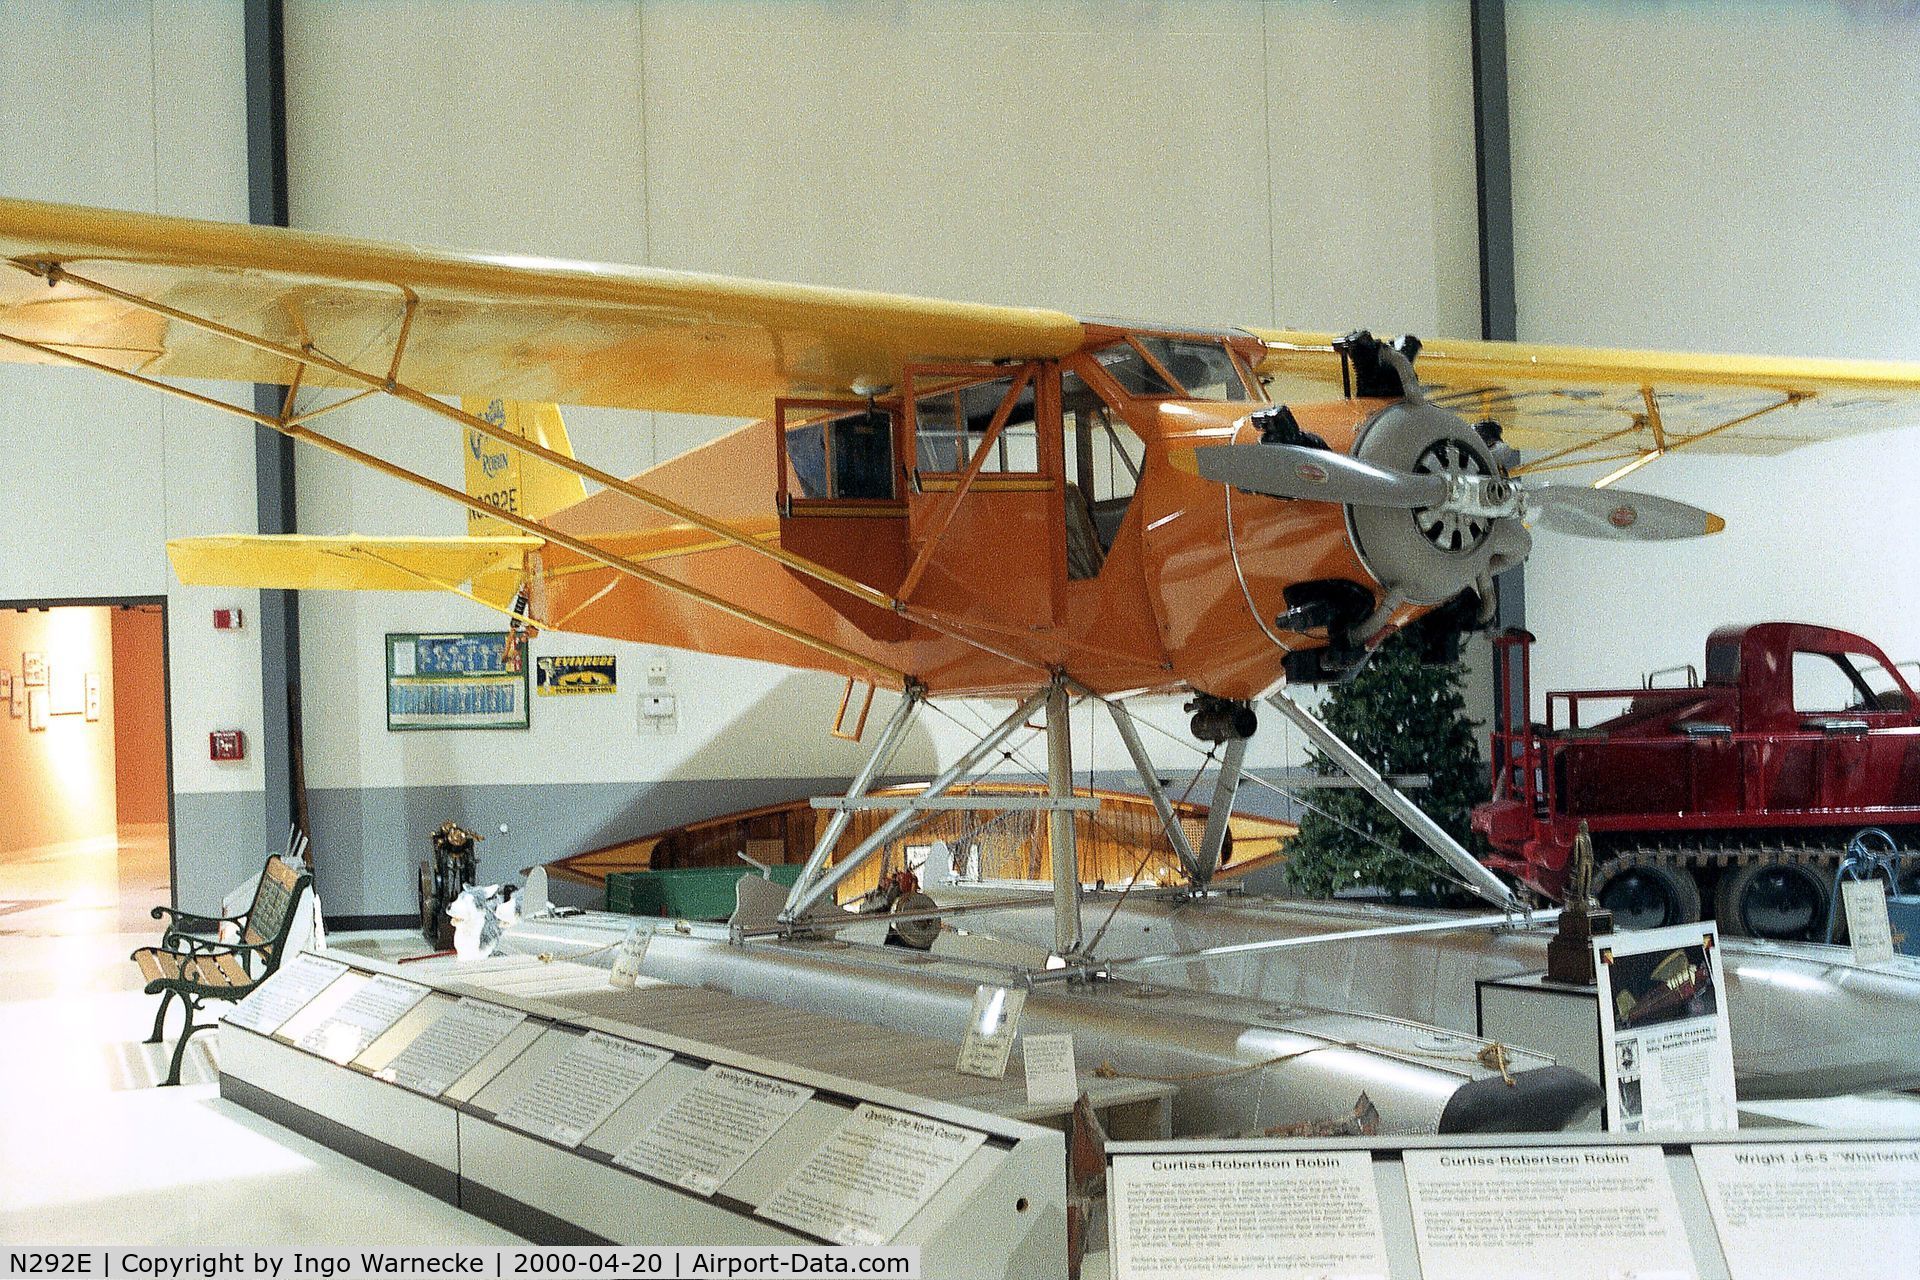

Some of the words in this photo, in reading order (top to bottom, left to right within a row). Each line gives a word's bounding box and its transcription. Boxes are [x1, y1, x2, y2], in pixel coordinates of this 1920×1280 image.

[1295, 1157, 1340, 1169] Robin
[1584, 1152, 1630, 1164] Robin
[1735, 1153, 1786, 1166] Wright
